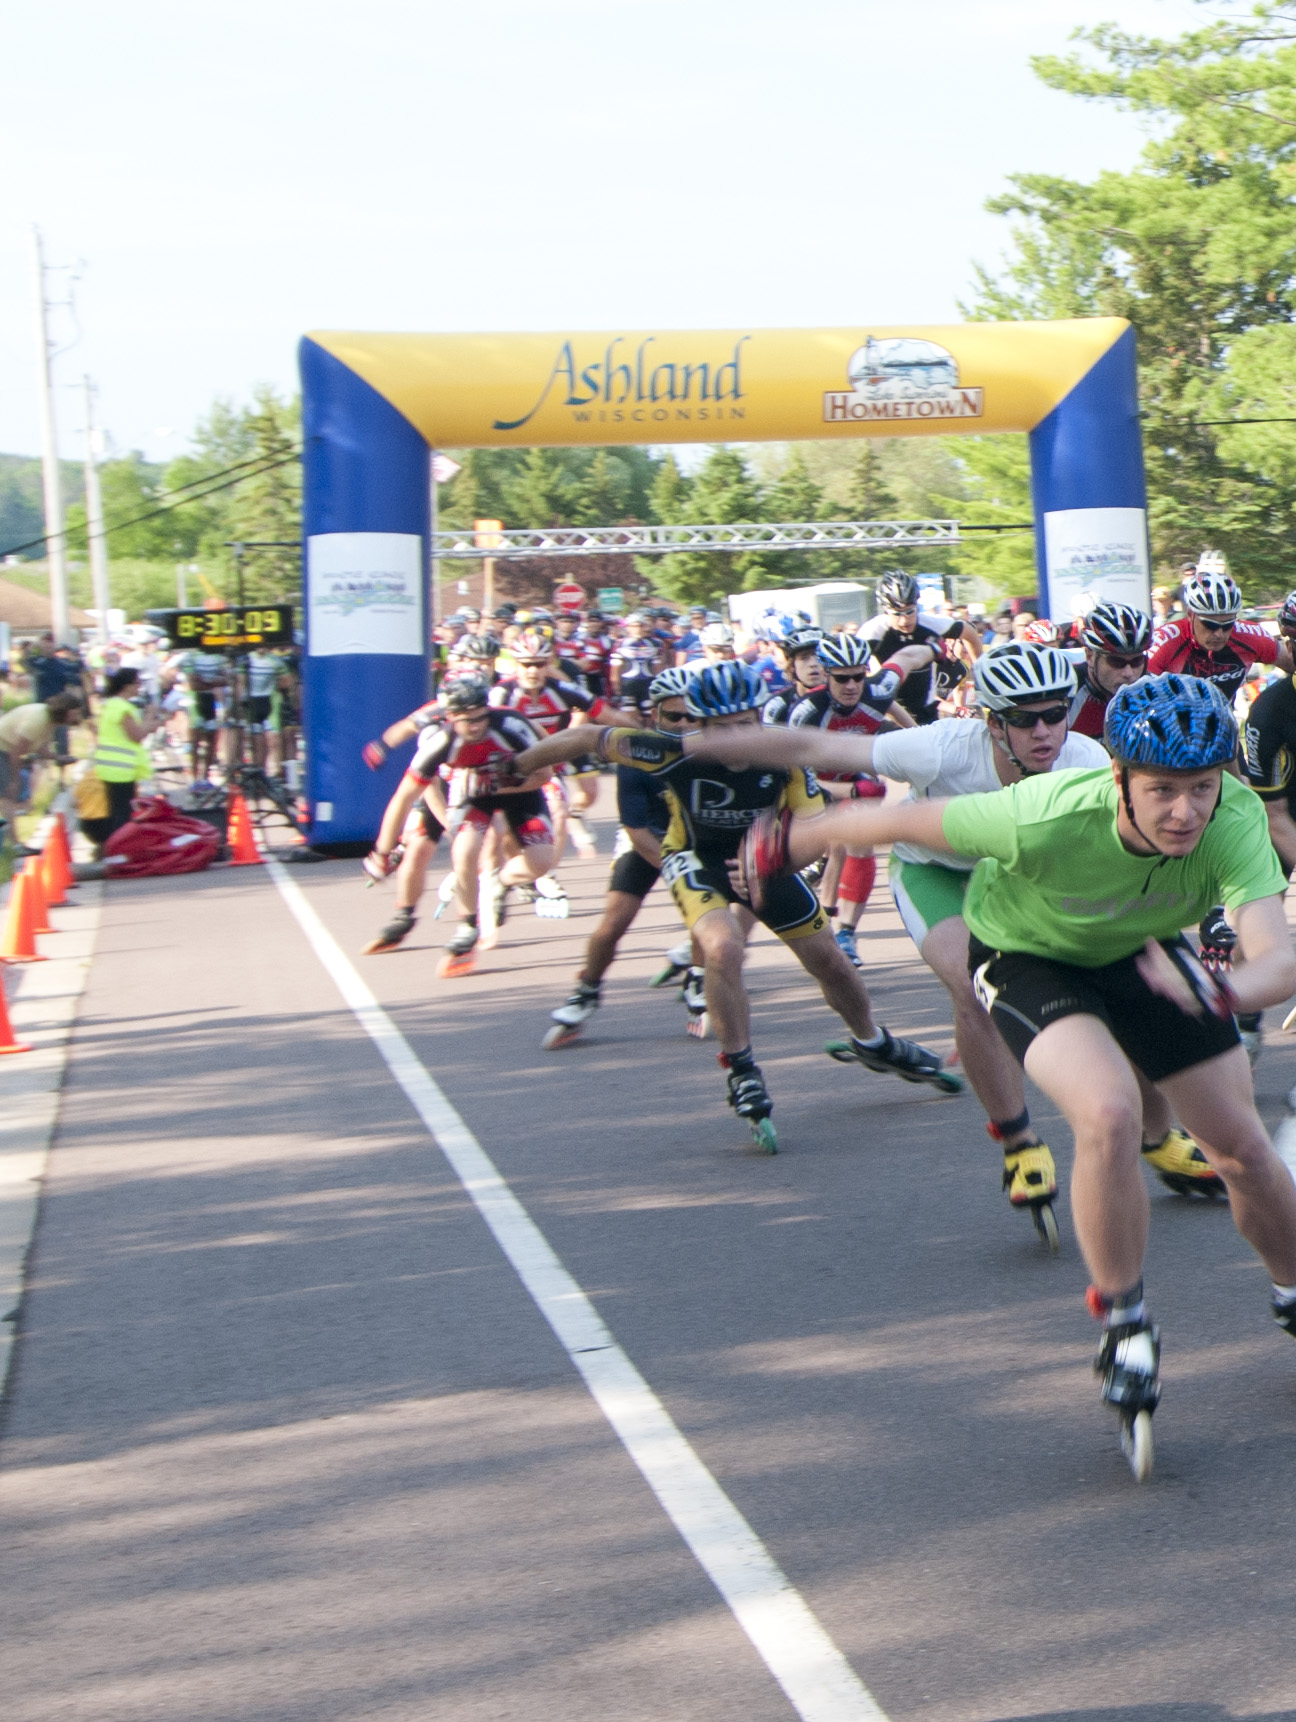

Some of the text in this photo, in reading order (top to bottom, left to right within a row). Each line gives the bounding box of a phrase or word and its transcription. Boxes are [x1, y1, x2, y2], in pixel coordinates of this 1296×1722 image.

[492, 335, 752, 430] Ashland
[572, 407, 746, 423] WISCONSIN
[830, 391, 978, 419] HOMETOWN
